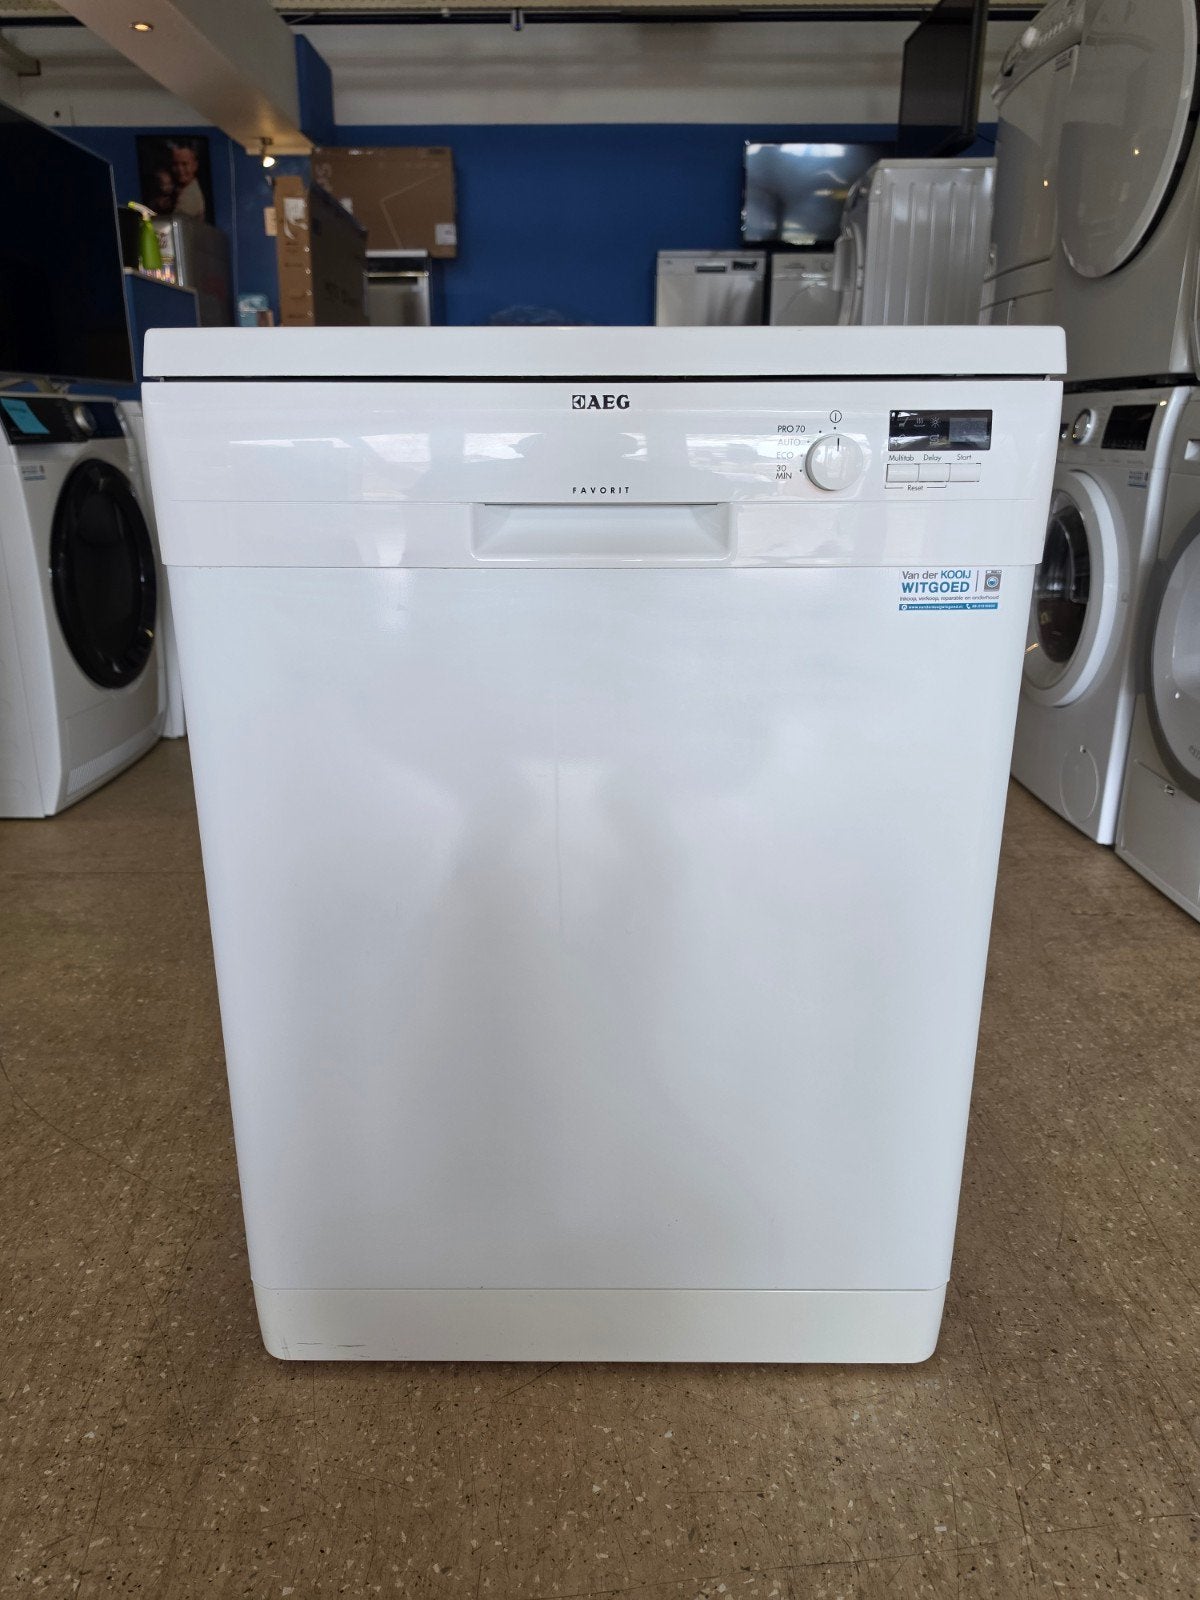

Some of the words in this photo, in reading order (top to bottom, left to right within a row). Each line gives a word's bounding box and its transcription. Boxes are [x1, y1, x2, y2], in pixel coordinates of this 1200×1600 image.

[586, 394, 630, 410] AEG
[777, 425, 794, 433] PRO
[795, 425, 805, 433] 70
[778, 438, 800, 446] AUTO
[888, 454, 915, 462] Multitab
[923, 454, 942, 462] Delay
[907, 484, 923, 492] Reset
[902, 571, 919, 579] Van
[922, 570, 938, 579] der
[941, 570, 971, 579] KOOIJ
[902, 582, 970, 593] WITGOED
